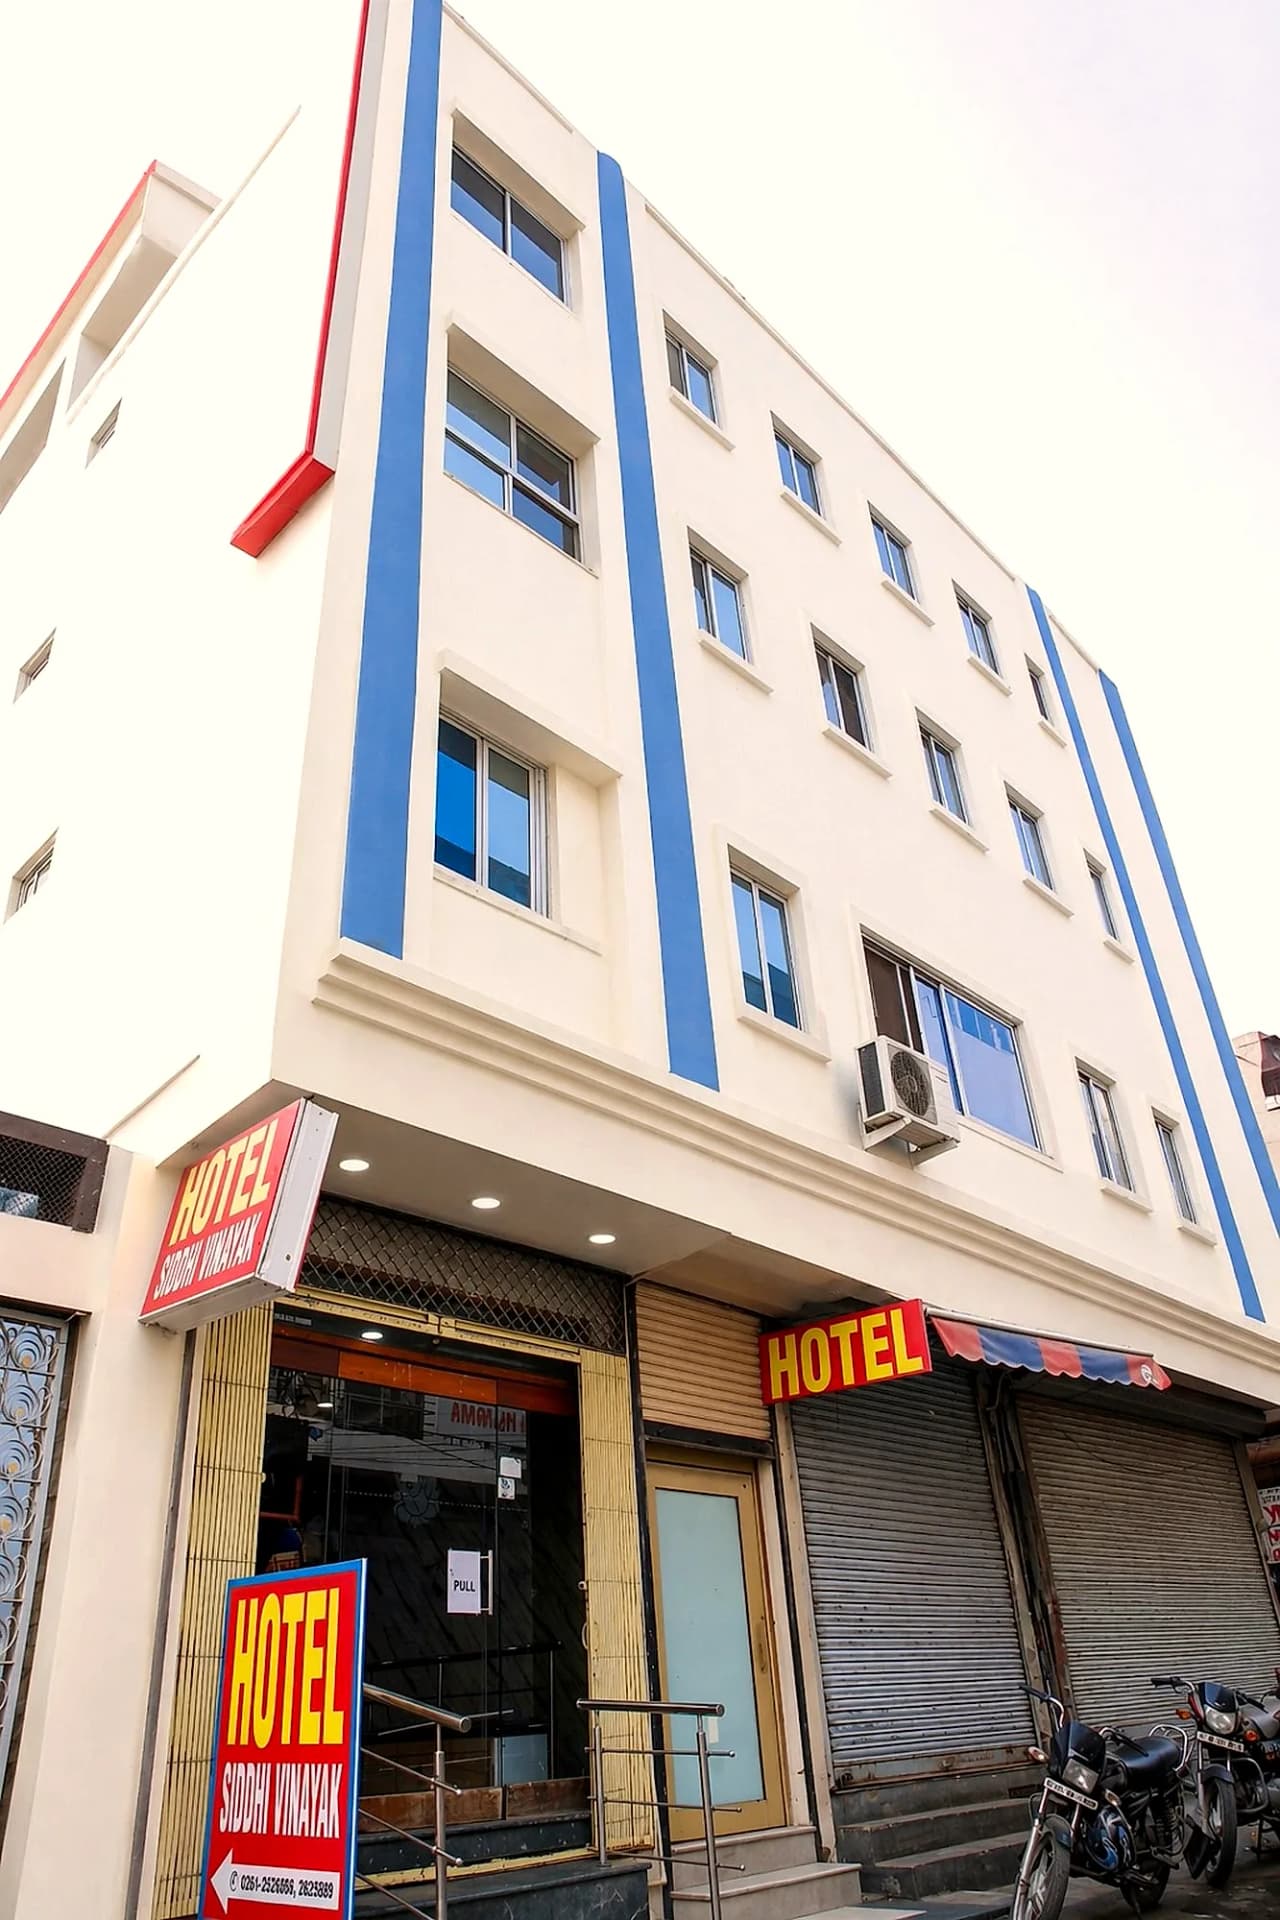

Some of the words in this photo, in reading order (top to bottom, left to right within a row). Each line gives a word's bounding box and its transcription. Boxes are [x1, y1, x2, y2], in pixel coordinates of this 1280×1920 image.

[168, 1118, 278, 1247] HOTEL
[153, 1239, 205, 1300] SIDDHI
[197, 1211, 262, 1281] VINAYAK
[768, 1308, 924, 1400] HOTEL
[453, 1580, 476, 1592] PULL
[227, 1587, 344, 1749] HOTEL
[219, 1762, 271, 1836] SIDDHI
[275, 1762, 344, 1839] VINAYAK
